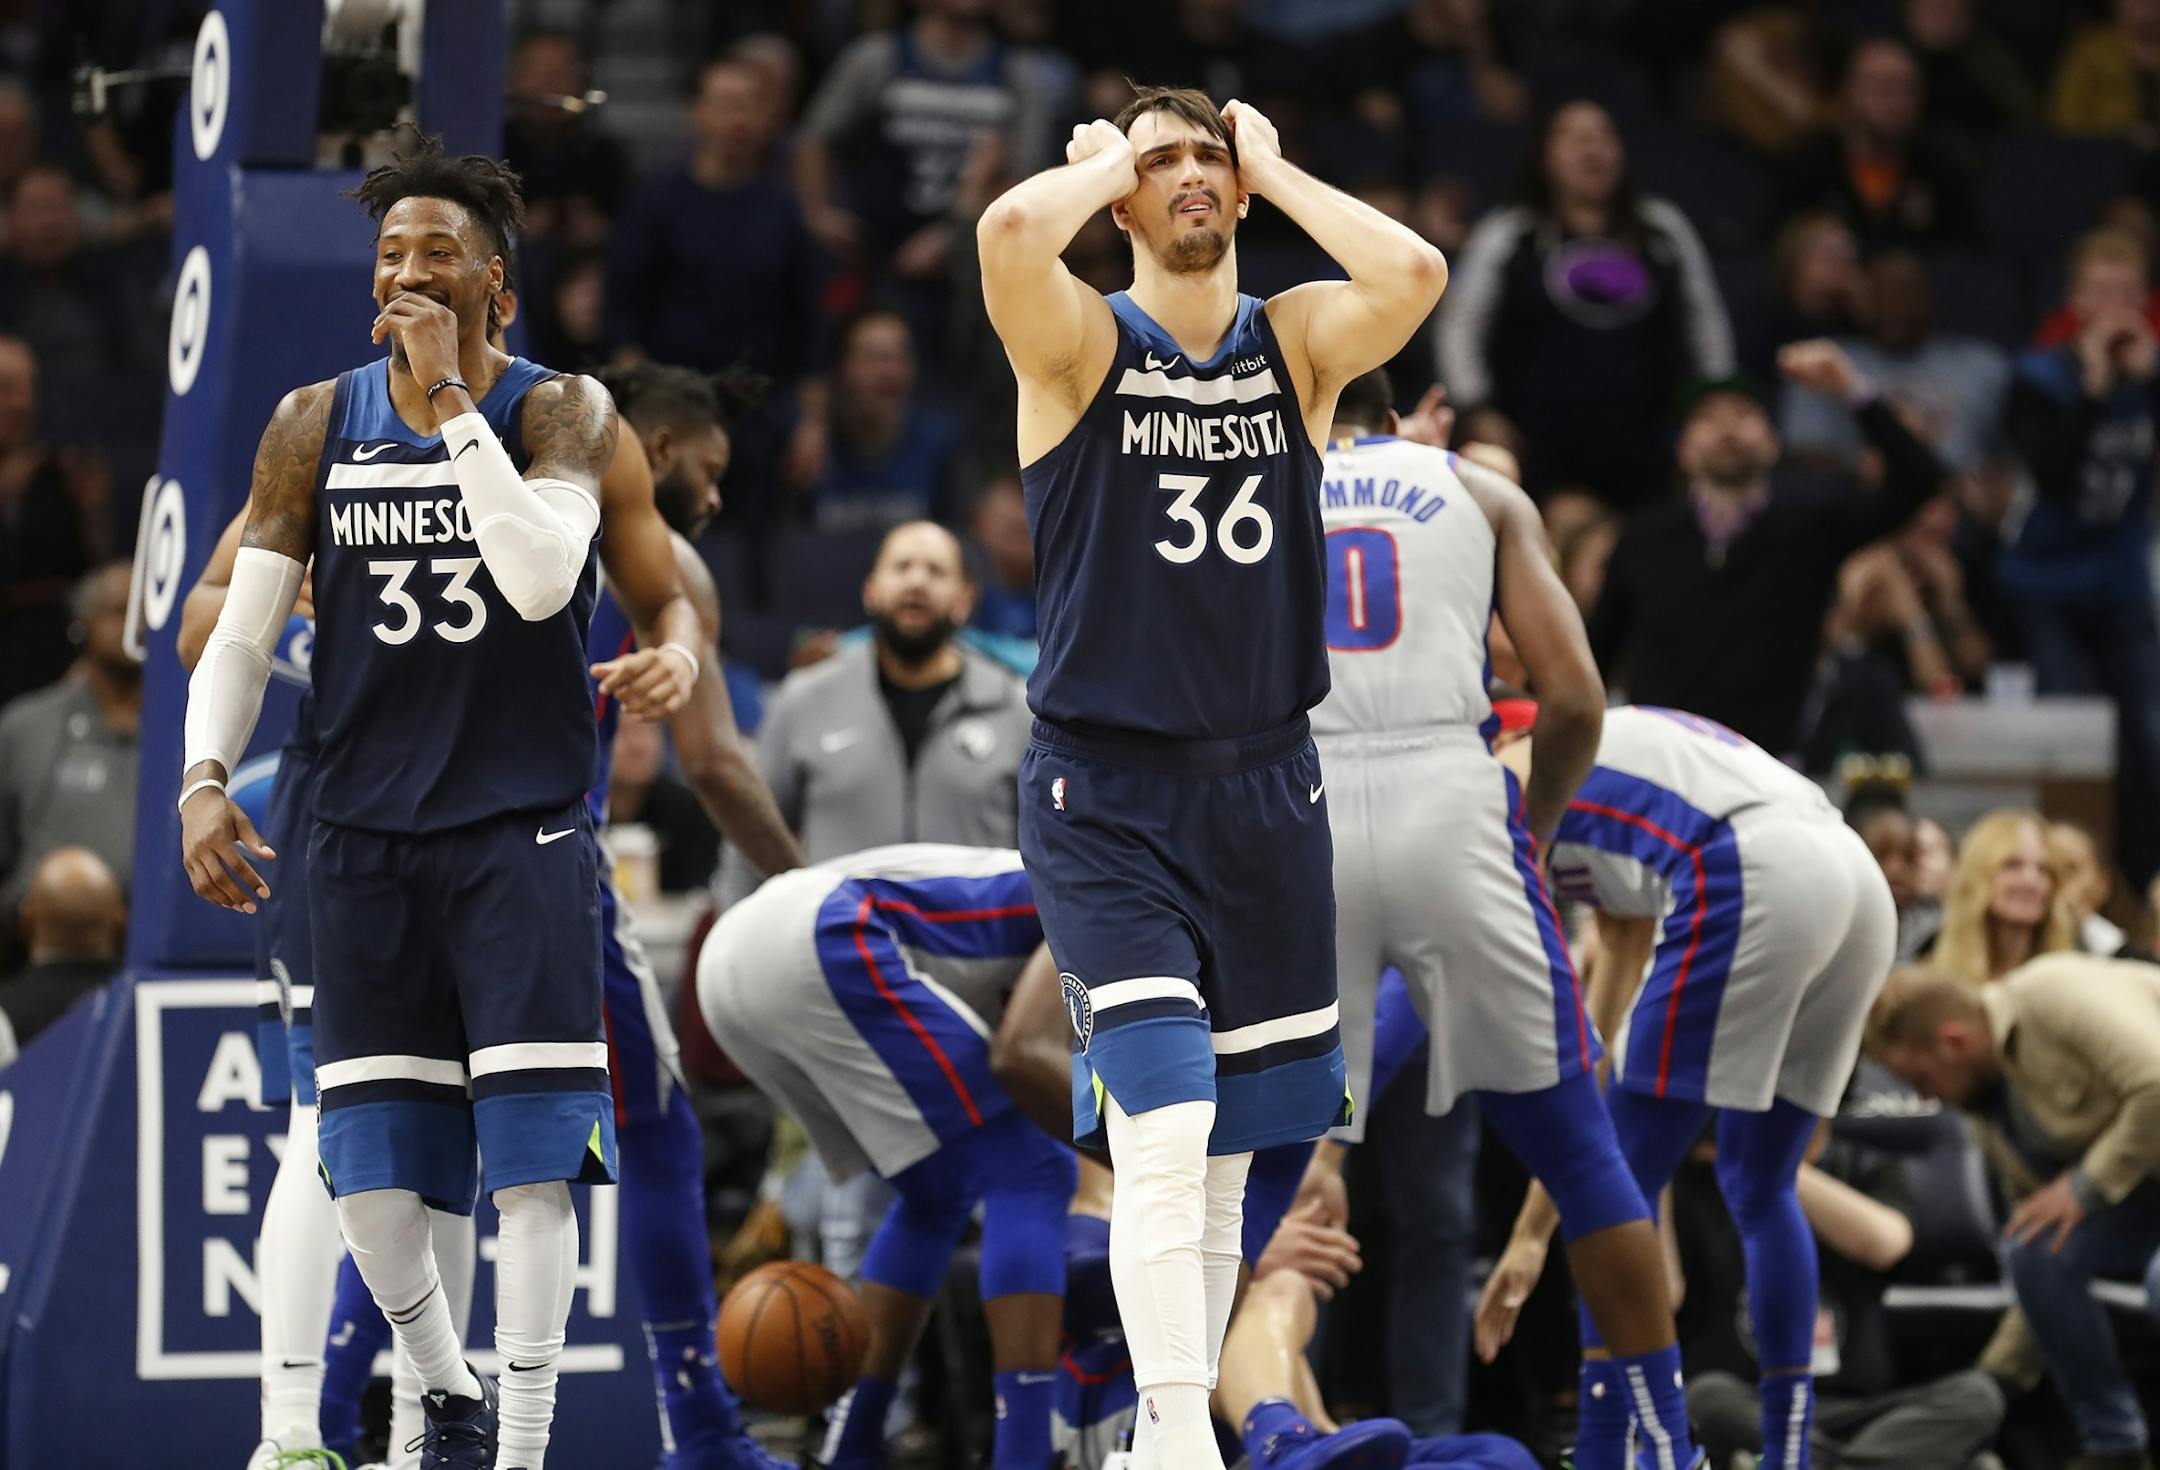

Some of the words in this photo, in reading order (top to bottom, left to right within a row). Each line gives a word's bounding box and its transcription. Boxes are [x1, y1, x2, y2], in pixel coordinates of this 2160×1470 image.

[1122, 409, 1288, 461] MINNESOTA
[1154, 473, 1274, 564] 36
[367, 557, 488, 645] 33
[1325, 526, 1402, 653] 0
